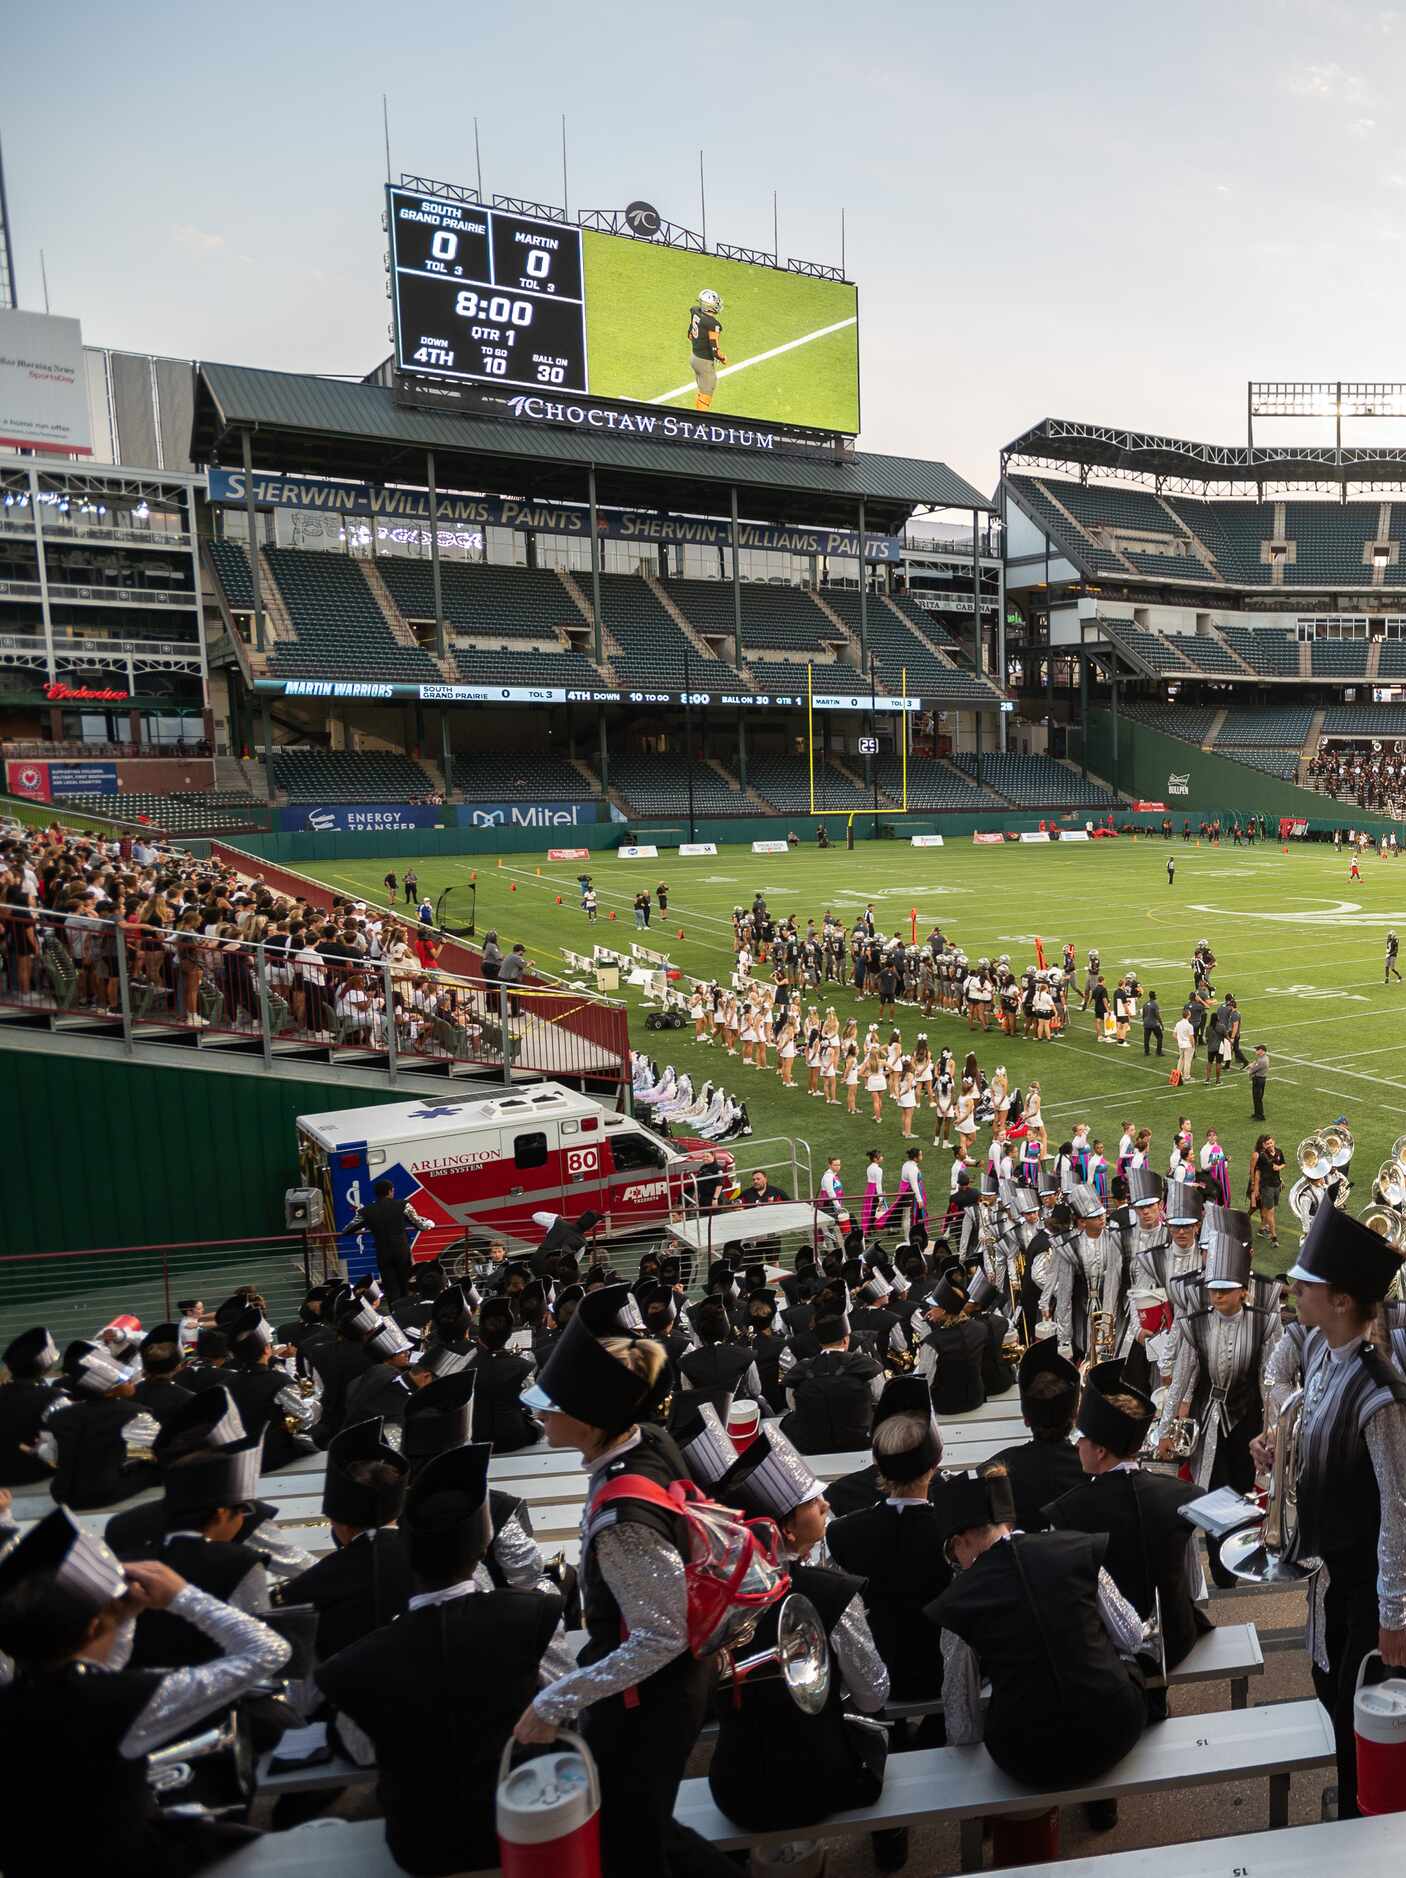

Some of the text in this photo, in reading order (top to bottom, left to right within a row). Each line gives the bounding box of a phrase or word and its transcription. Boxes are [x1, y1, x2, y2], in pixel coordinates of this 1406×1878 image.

[421, 202, 462, 218] SOUTH
[400, 208, 486, 235] GRAND PRAIRIE
[432, 230, 458, 260] 0
[515, 232, 559, 250] MARTIN
[425, 260, 464, 276] TOL 3
[526, 249, 550, 278] 0
[520, 278, 555, 292] TOL 3
[456, 290, 533, 326] 8:00
[420, 336, 448, 348] DOWN
[471, 326, 516, 346] QTR 1
[414, 347, 454, 366] 4TH
[481, 346, 508, 357] TO GO
[483, 357, 506, 374] 10
[532, 354, 568, 366] BALL ON
[536, 365, 564, 384] 30
[524, 398, 774, 448] CHOCTAW STADIUM
[501, 503, 581, 529] PAINTS
[284, 682, 392, 698] MARTIN WARRIORS
[501, 689, 510, 699] 0
[545, 690, 552, 699] 3
[567, 692, 620, 701] 4TH DOWN
[630, 692, 642, 702] 10
[722, 696, 769, 705] BALL ON 30
[776, 697, 792, 705] QTR
[850, 699, 858, 708] 0
[906, 699, 912, 708] 3
[862, 740, 875, 752] 25
[348, 812, 402, 824] ENERGY
[512, 805, 578, 826] Mitel
[410, 1150, 501, 1173] ARLINGTON
[568, 1150, 598, 1172] 80
[430, 1163, 484, 1178] EMS SYSTEM
[622, 1182, 668, 1202] AMR
[1196, 1738, 1208, 1746] 15
[1232, 1868, 1248, 1877] 15
